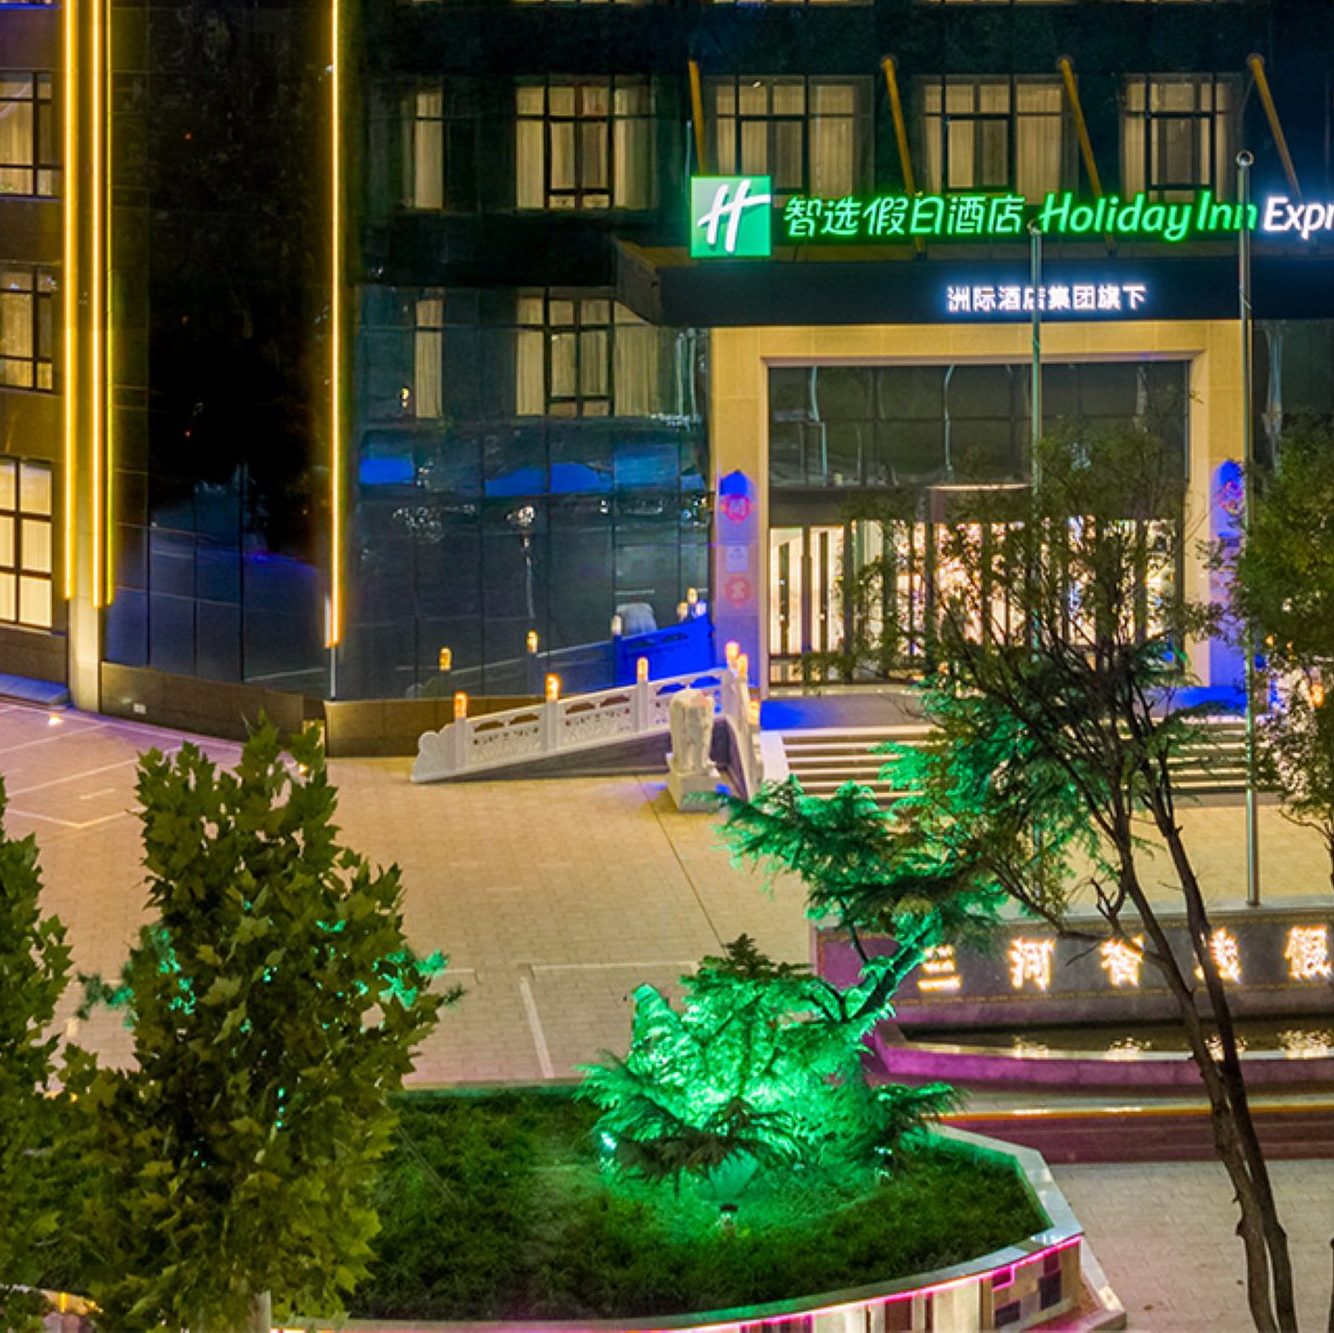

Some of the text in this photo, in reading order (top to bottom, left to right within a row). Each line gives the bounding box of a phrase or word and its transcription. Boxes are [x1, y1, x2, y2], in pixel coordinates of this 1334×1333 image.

[784, 194, 1025, 237] 智选假日酒店
[1040, 191, 1192, 242] Holiday
[1196, 190, 1259, 232] Inn
